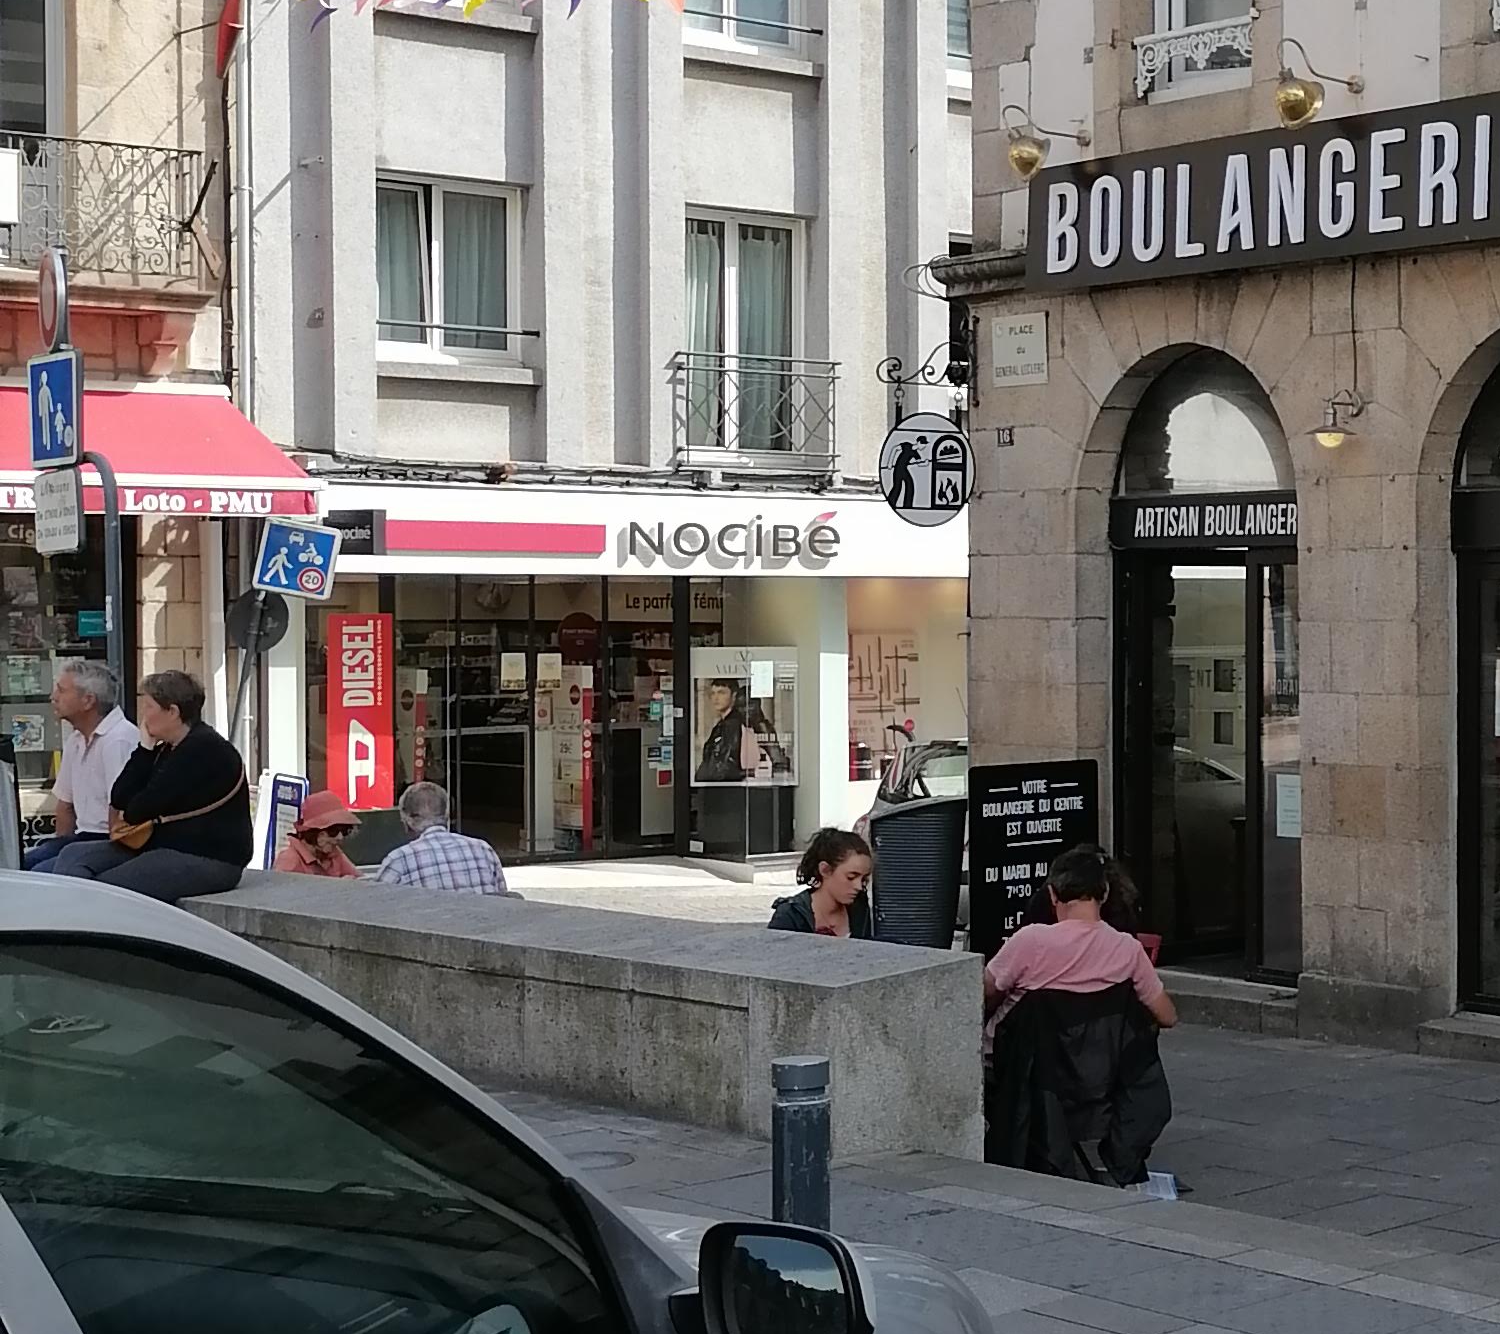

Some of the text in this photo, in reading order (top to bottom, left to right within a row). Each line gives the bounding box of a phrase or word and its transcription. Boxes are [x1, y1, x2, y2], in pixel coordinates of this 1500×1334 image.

[1008, 324, 1034, 336] PLACE
[999, 428, 1011, 444] 16
[124, 489, 186, 512] Loto
[209, 490, 273, 514] PMU
[1134, 503, 1298, 538] ARTISAN BOULANGER
[304, 574, 320, 586] 20
[625, 593, 640, 609] Le
[342, 619, 375, 707] DIESEL
[1021, 779, 1048, 795] VOTRE
[982, 795, 1084, 818] BOULANGERIE DU CENTRE
[1006, 817, 1063, 836] EST OUVERTE
[985, 862, 1048, 883] DU MARDI AU
[1004, 916, 1014, 930] LE
